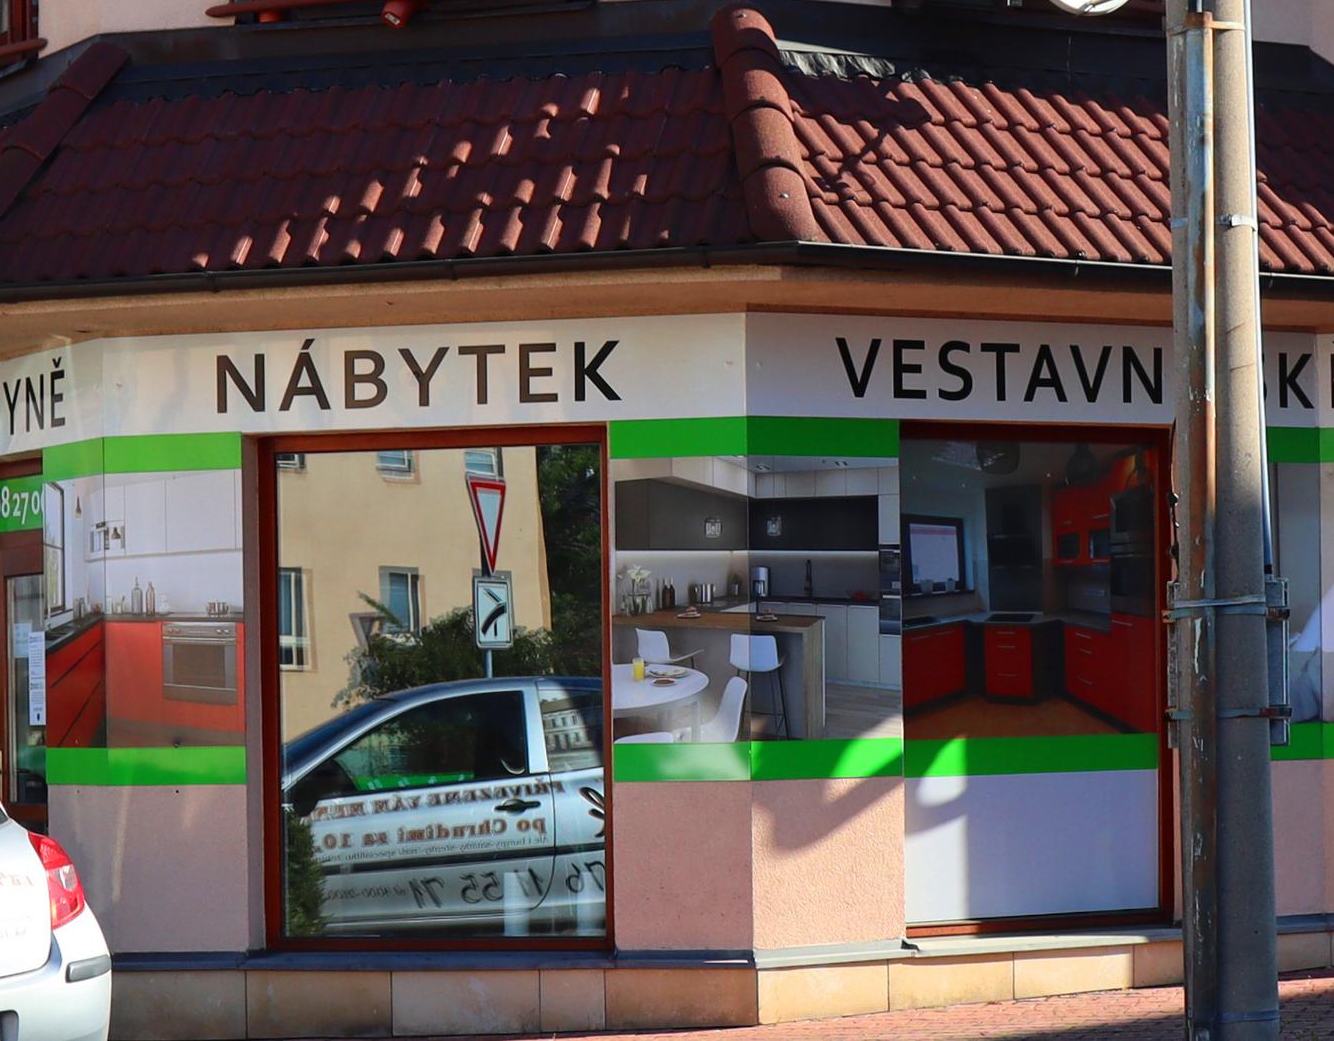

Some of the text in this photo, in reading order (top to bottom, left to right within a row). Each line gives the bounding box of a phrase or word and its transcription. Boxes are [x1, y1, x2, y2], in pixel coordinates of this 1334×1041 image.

[216, 338, 622, 414] NÁBYTEK
[835, 335, 1164, 405] VESTAVN
[31, 490, 44, 515] 0
